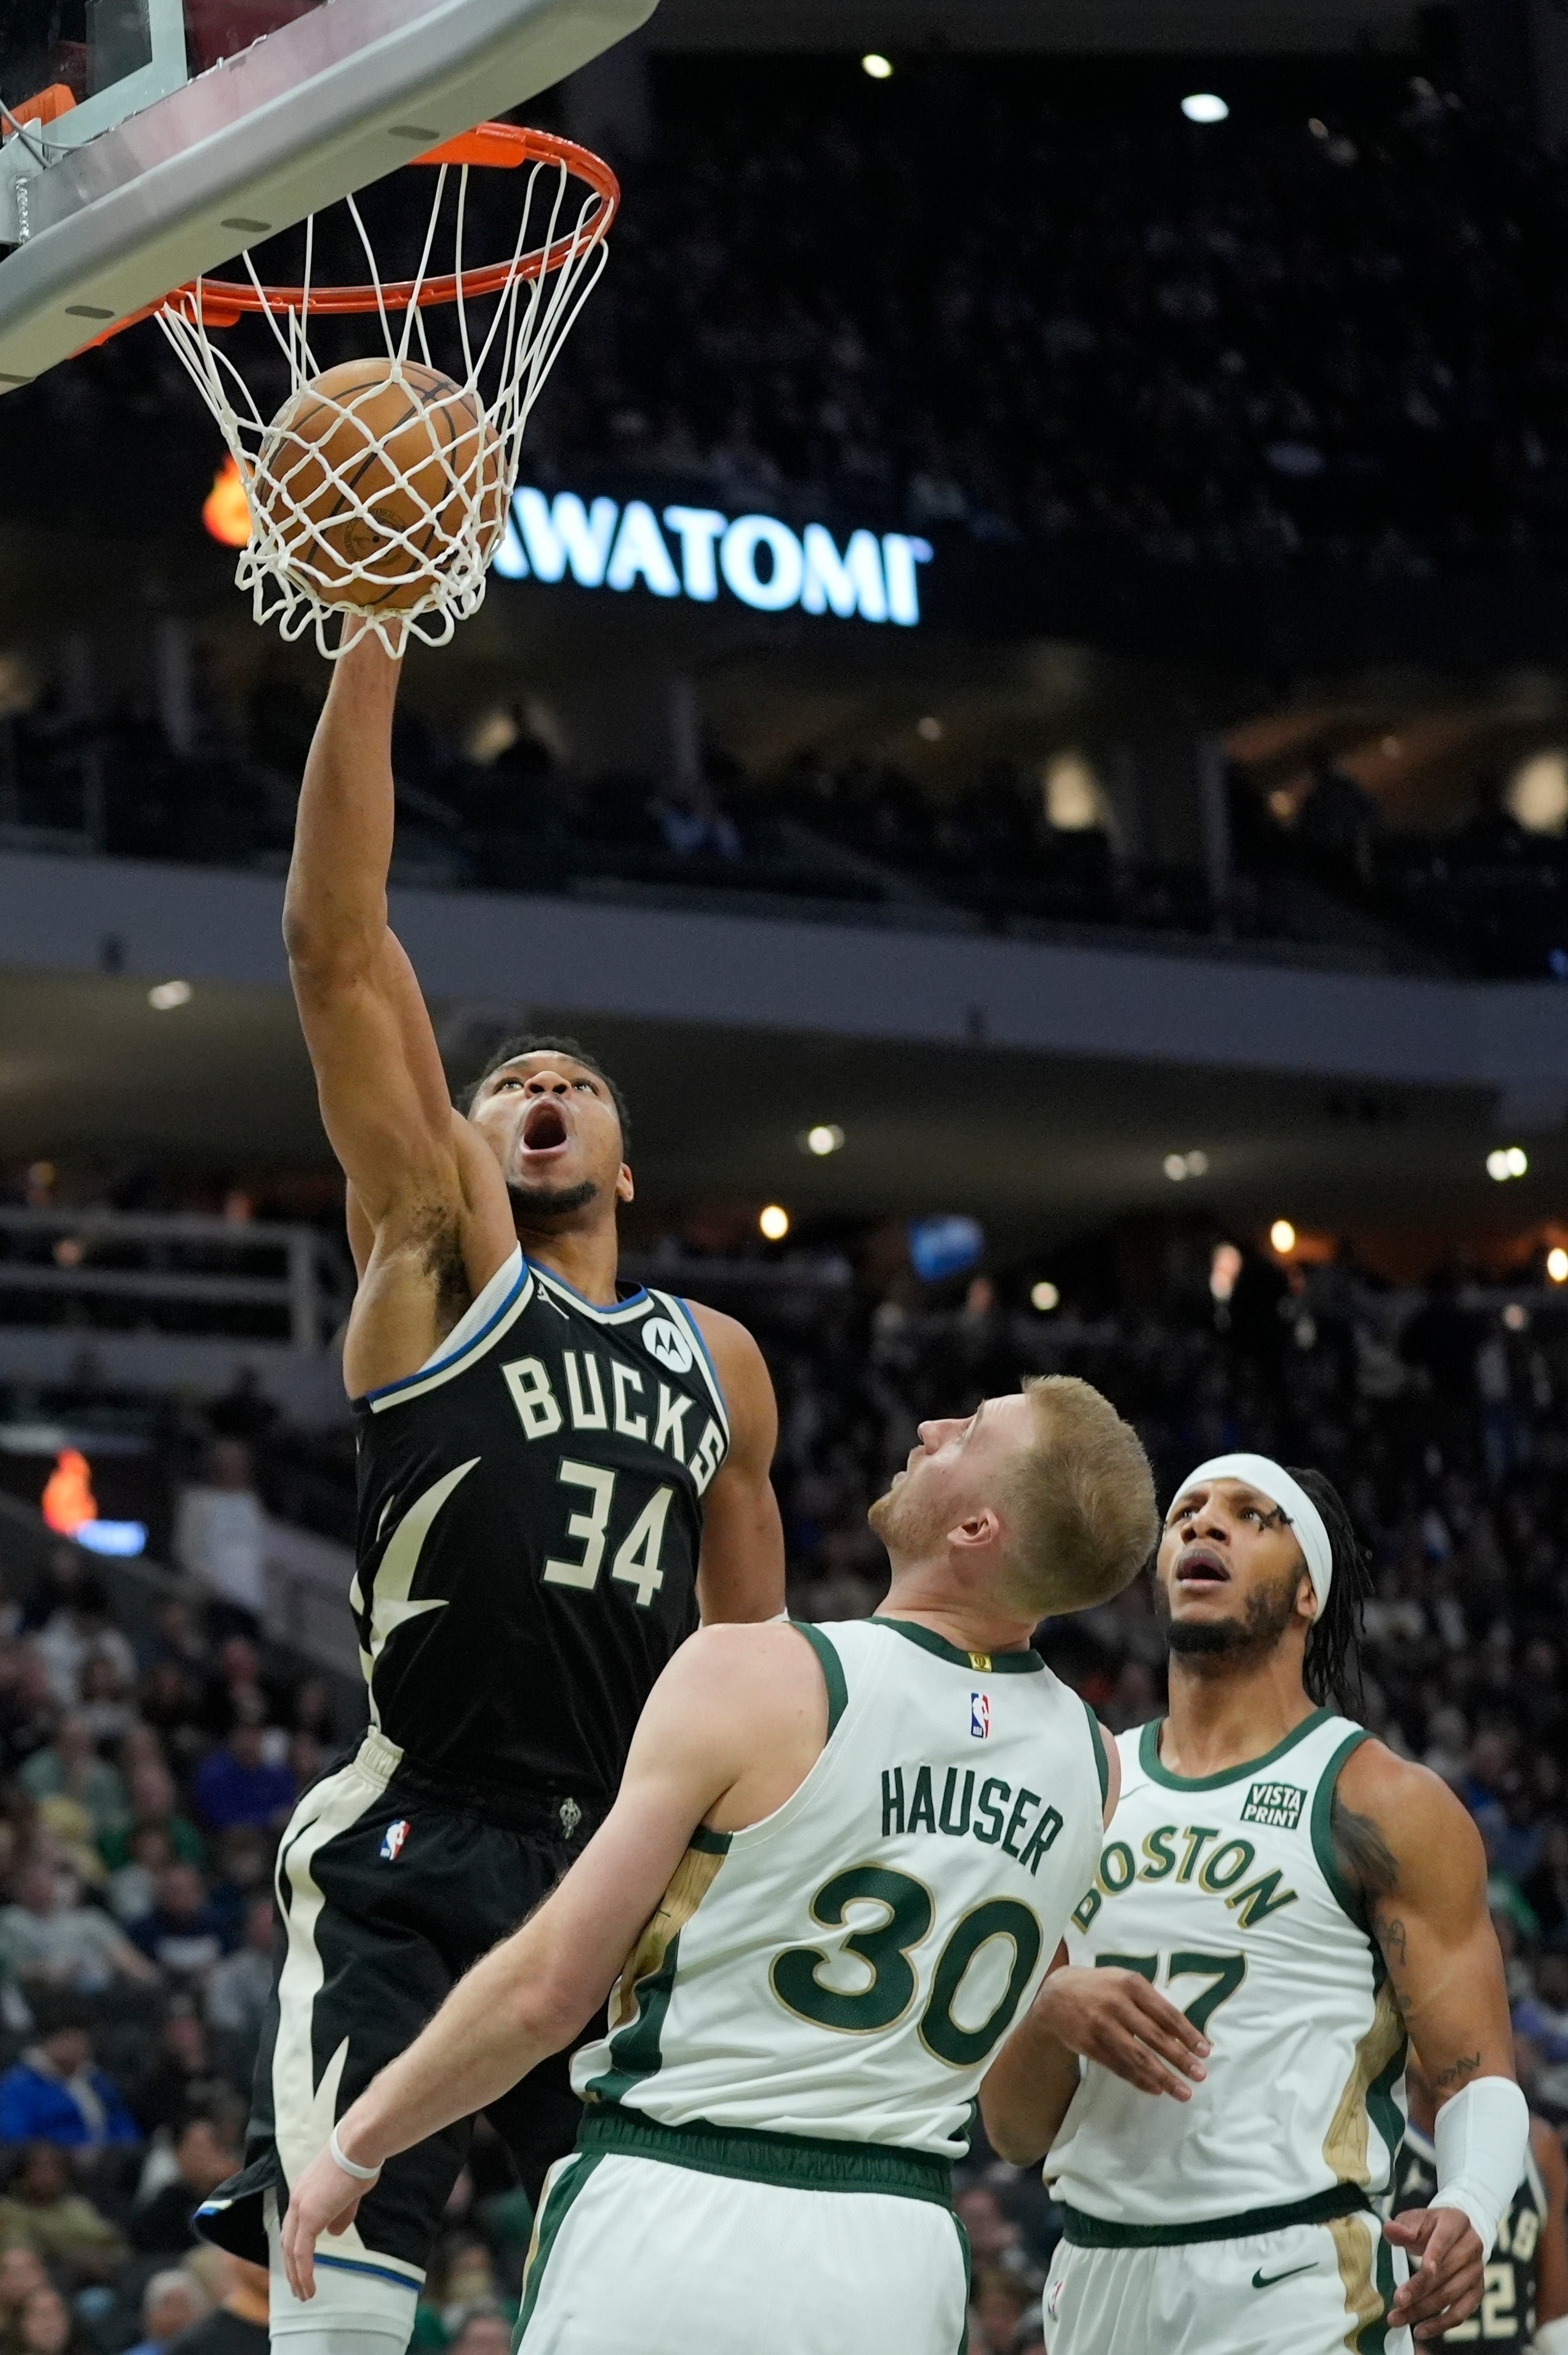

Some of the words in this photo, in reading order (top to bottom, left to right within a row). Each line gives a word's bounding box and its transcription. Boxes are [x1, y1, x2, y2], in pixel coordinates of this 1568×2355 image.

[500, 1351, 725, 1498] BUCKS
[542, 1458, 674, 1607] 34
[881, 1765, 1064, 1877] HAUSER
[1243, 1803, 1299, 1828] PRINT
[1252, 1784, 1302, 1811] VISTA
[769, 1861, 1044, 2069] 30
[1442, 2261, 1519, 2343] 2
